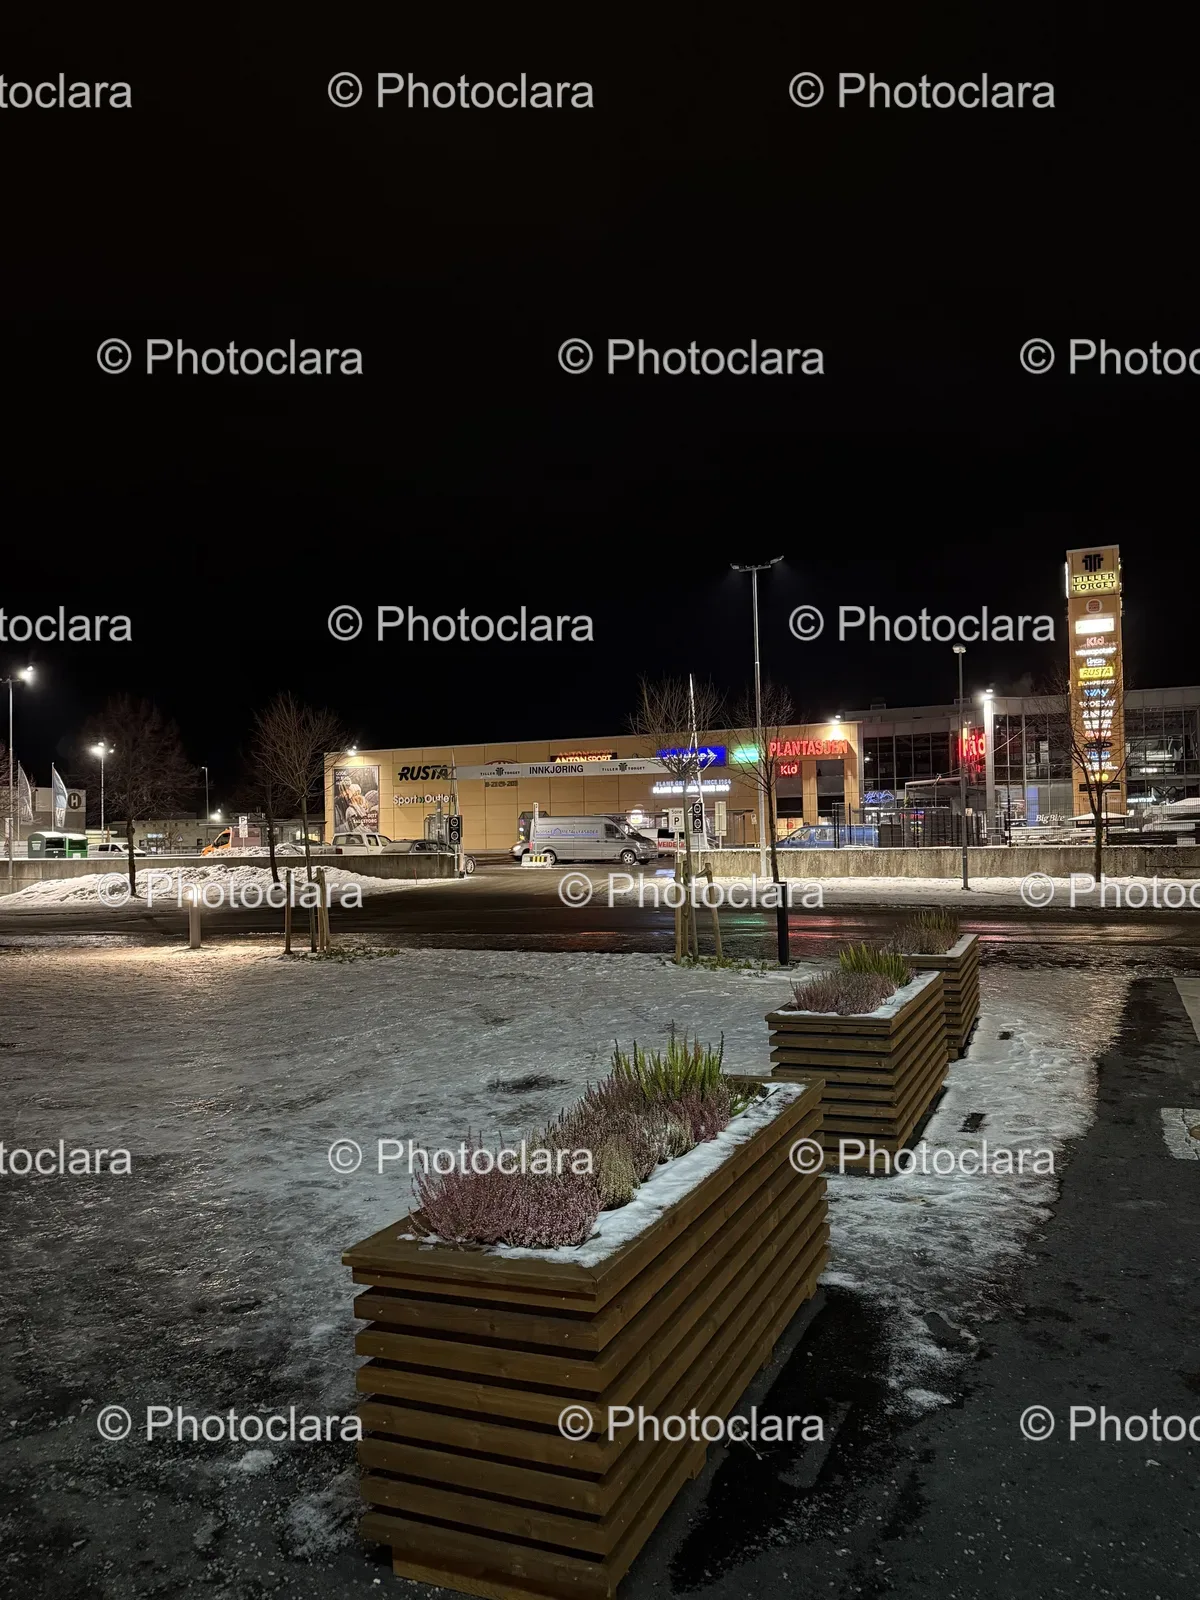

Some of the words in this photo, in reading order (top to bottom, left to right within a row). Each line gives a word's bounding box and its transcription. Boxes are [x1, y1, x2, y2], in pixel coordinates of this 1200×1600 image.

[1073, 573, 1115, 583] TILLER
[1073, 581, 1115, 591] TORGET
[1083, 668, 1111, 676] RUSTA
[769, 740, 848, 757] PLANTASJEN
[398, 765, 449, 781] RUSTA
[529, 765, 584, 775] INNKJØRING
[393, 795, 418, 805] Sport
[674, 817, 679, 825] P
[1035, 814, 1049, 824] Big
